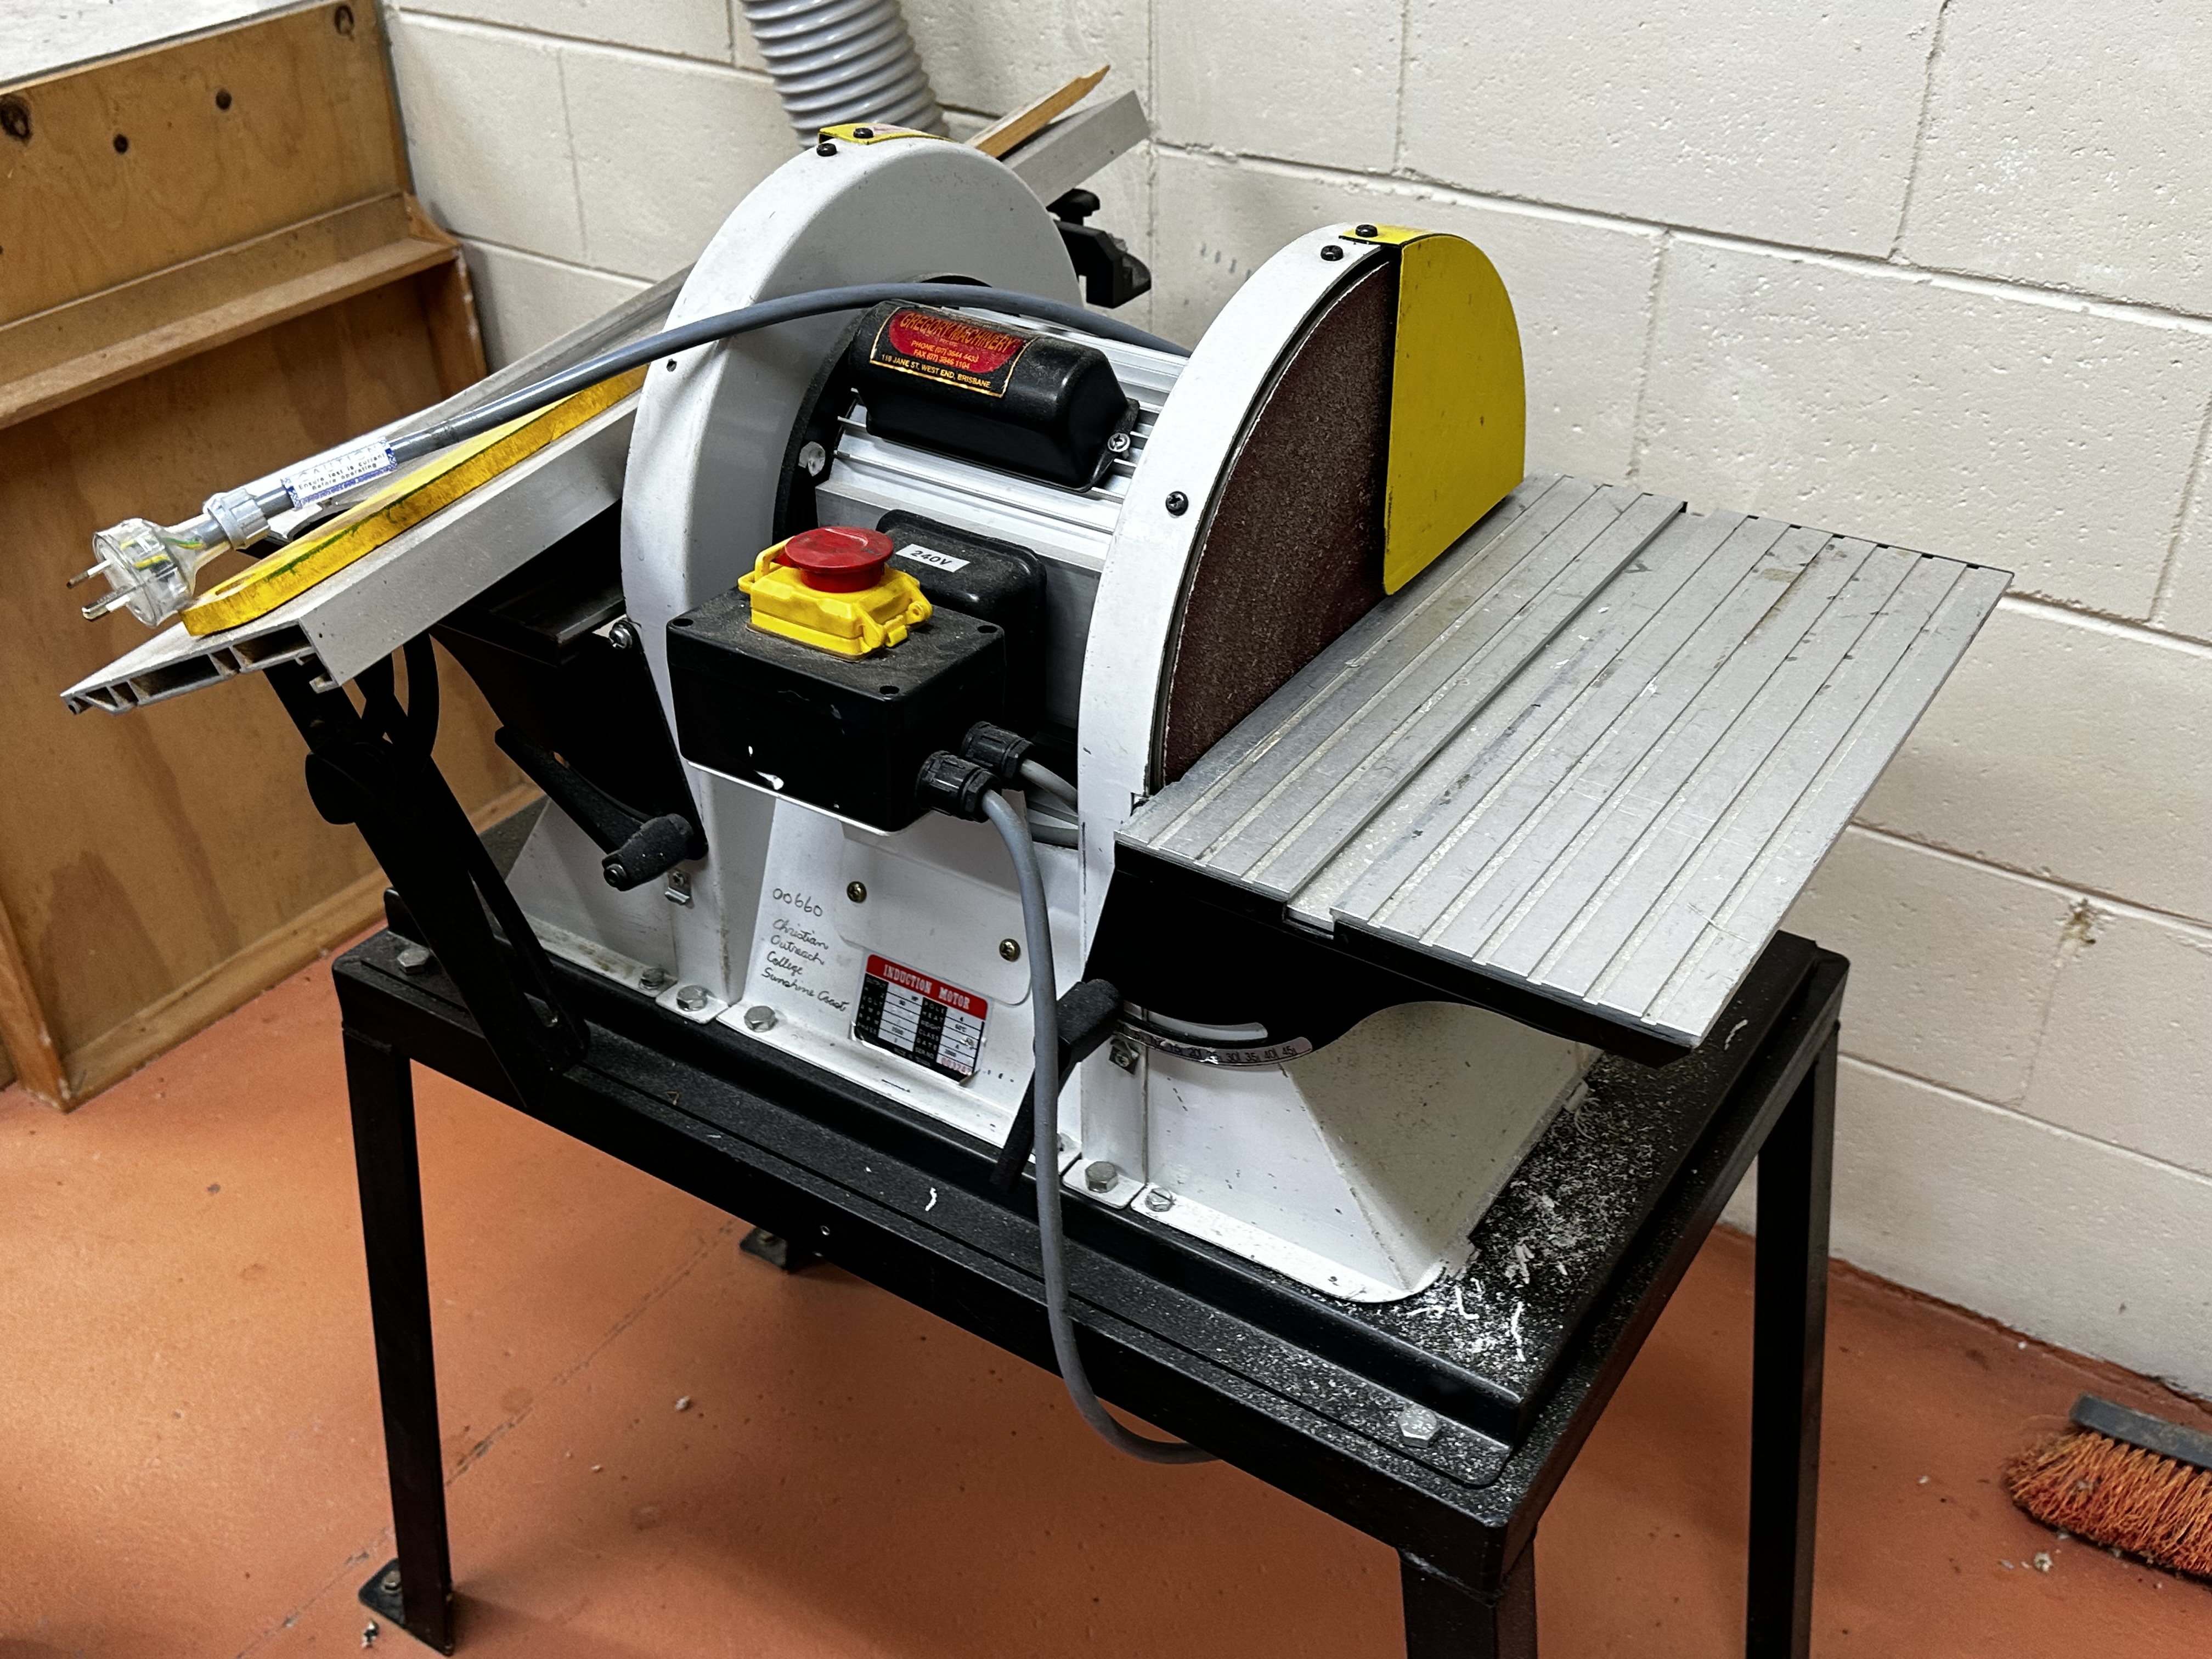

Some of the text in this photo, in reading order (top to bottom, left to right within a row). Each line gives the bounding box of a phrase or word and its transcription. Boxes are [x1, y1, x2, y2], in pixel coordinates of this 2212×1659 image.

[900, 313, 1014, 353] GREGORY MACHINERY
[911, 341, 934, 352] PHONE
[913, 349, 926, 358] FAX
[893, 357, 909, 367] JANE
[922, 364, 940, 374] WEST
[957, 372, 991, 388] BRISBANE
[298, 477, 325, 490] Ensure
[358, 453, 386, 465] current
[341, 462, 377, 480] operating
[910, 550, 953, 565] 240V
[772, 888, 823, 917] 00660
[772, 919, 828, 950] Christian
[771, 935, 825, 965] Outreach
[767, 951, 803, 976] College
[761, 967, 850, 1011] Sunshine Coast
[883, 964, 970, 1010] INDUCTION MOTOR
[922, 1011, 944, 1023] HEAT
[924, 1001, 945, 1014] POLE
[918, 1029, 939, 1040] CLASS
[1226, 1053, 1238, 1062] 30
[1245, 1052, 1256, 1062] 35
[1264, 1048, 1274, 1059] 40
[1282, 1046, 1293, 1056] 45
